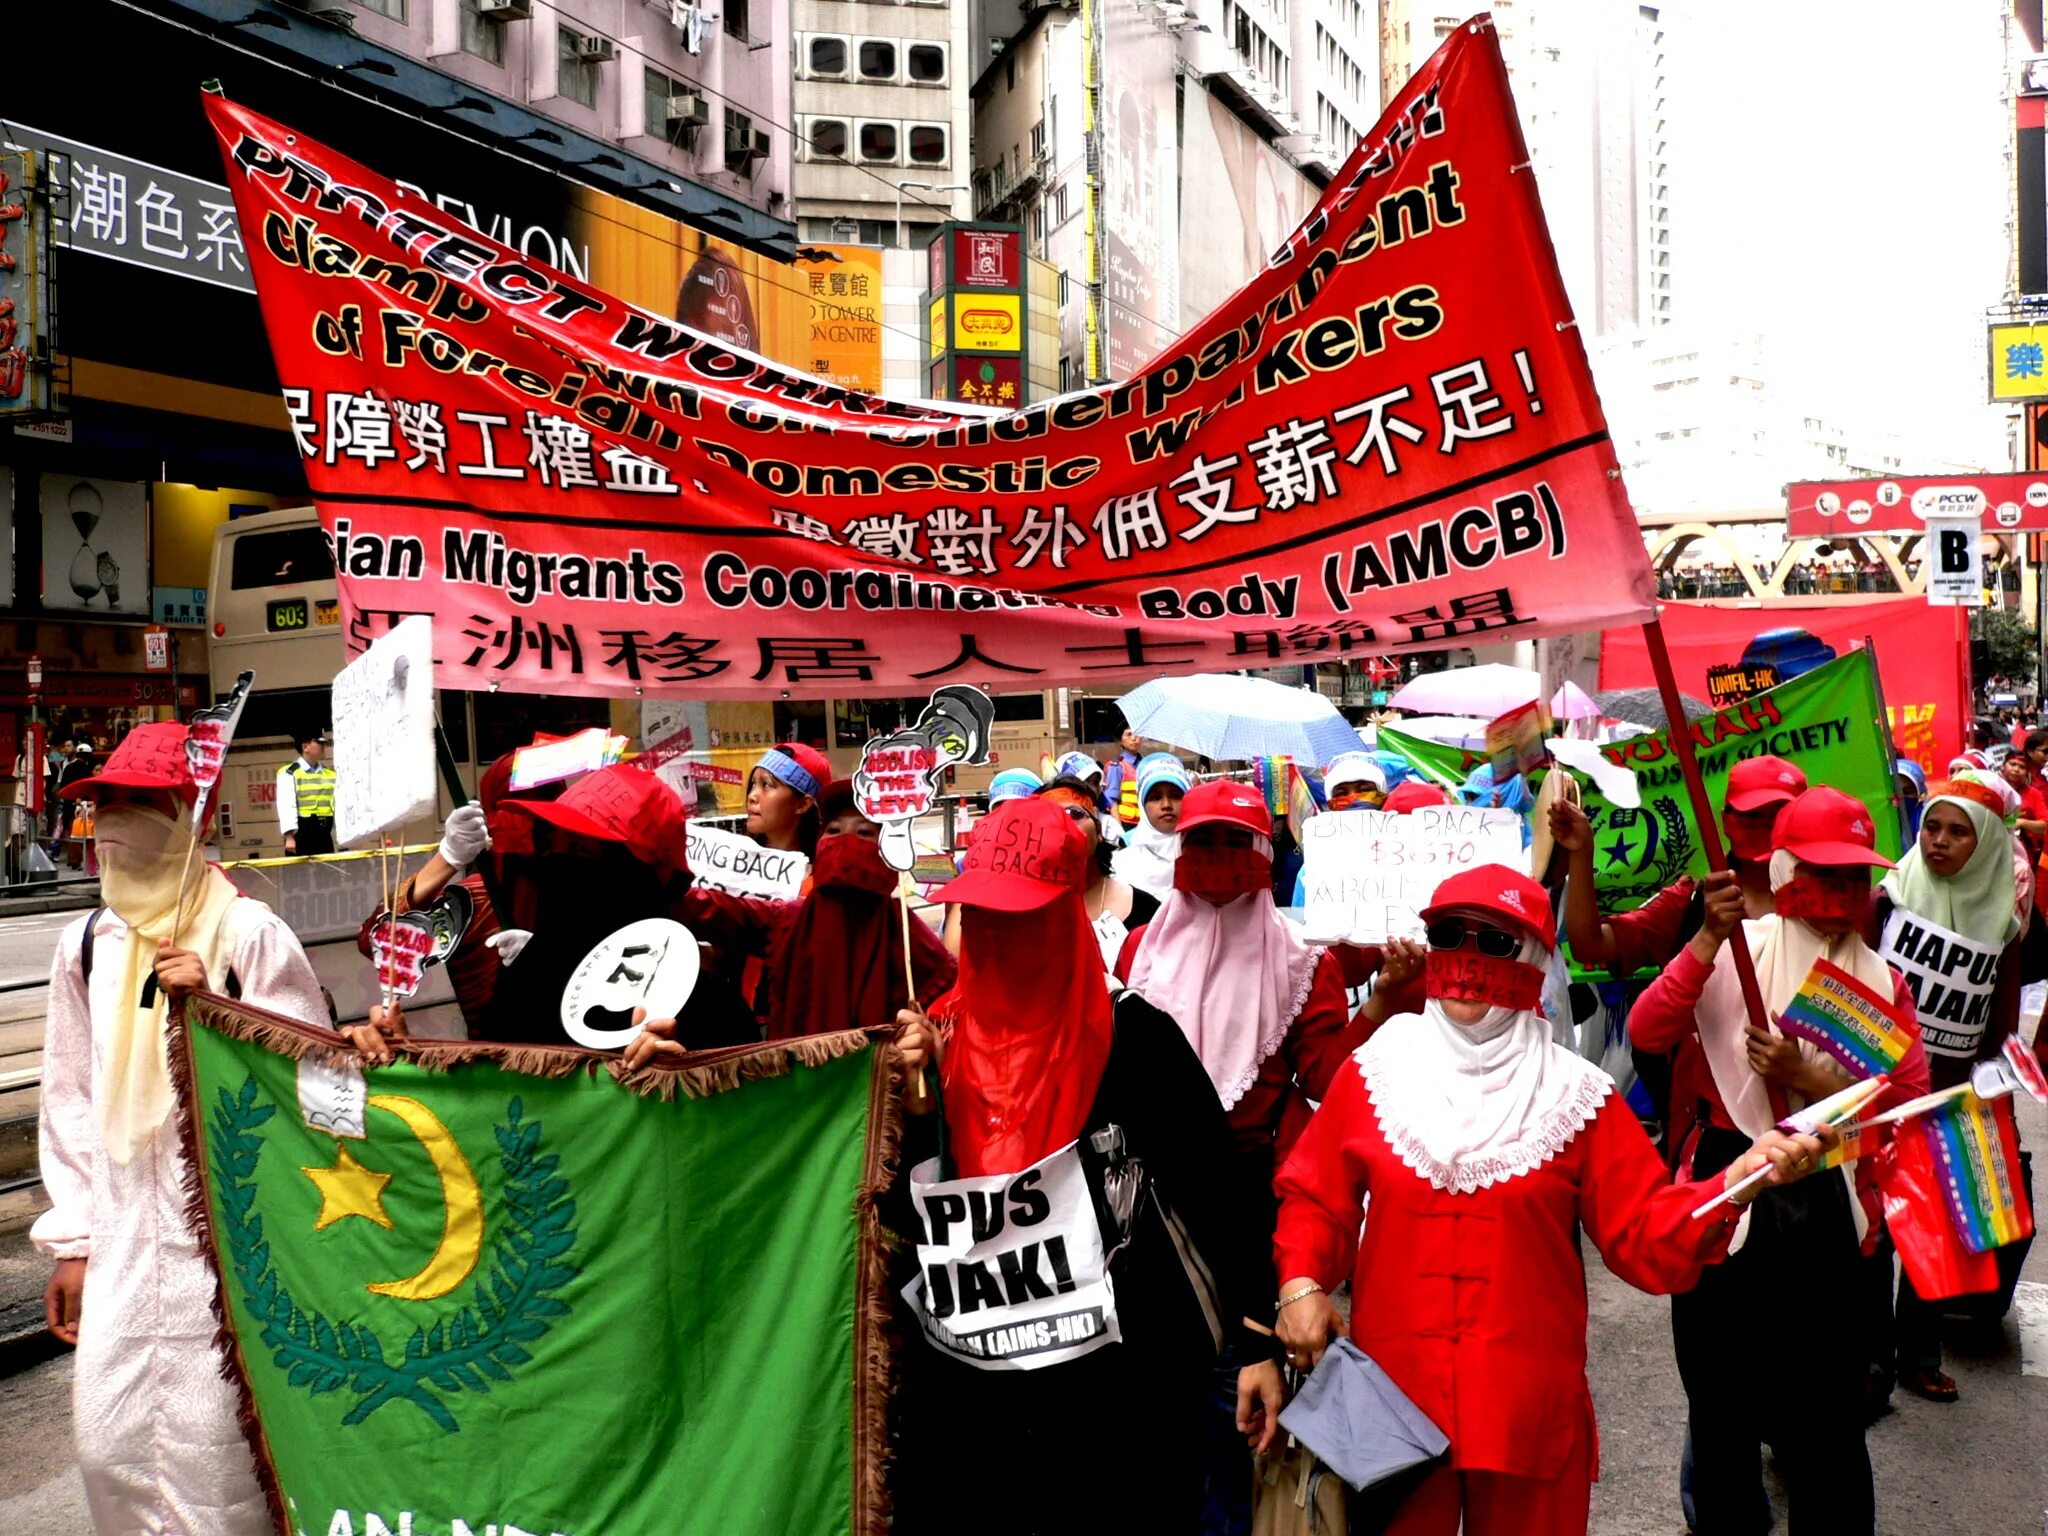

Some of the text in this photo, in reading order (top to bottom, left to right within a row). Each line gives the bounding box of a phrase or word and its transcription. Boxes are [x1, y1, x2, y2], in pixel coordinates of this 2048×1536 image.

[48, 154, 246, 273] 潮色系
[263, 209, 490, 323] Clamp
[821, 305, 876, 323] TOWER
[829, 325, 877, 344] CENTRE
[2006, 343, 2044, 380] 樂
[312, 305, 362, 352] of
[380, 308, 683, 450] Foreign
[693, 436, 1101, 498] Domestic
[1938, 493, 1978, 504] PCCW
[442, 527, 684, 606] Migrants
[1139, 573, 1302, 621] Body
[1321, 482, 1568, 613] (AMCB)
[1941, 530, 1969, 573] B
[275, 606, 305, 628] 603
[1709, 669, 1776, 696] UNIFIL-HK
[1736, 715, 1850, 762] SOCIETY
[864, 749, 938, 774] ABOLISH
[874, 773, 917, 791] THE
[864, 794, 927, 815] LEVY
[1313, 809, 1495, 838] BRING BACK
[732, 848, 796, 885] BACK
[922, 1169, 1051, 1247] PUS
[927, 1234, 1077, 1319] JAK!
[986, 1312, 1096, 1356] (AIMS-HK)
